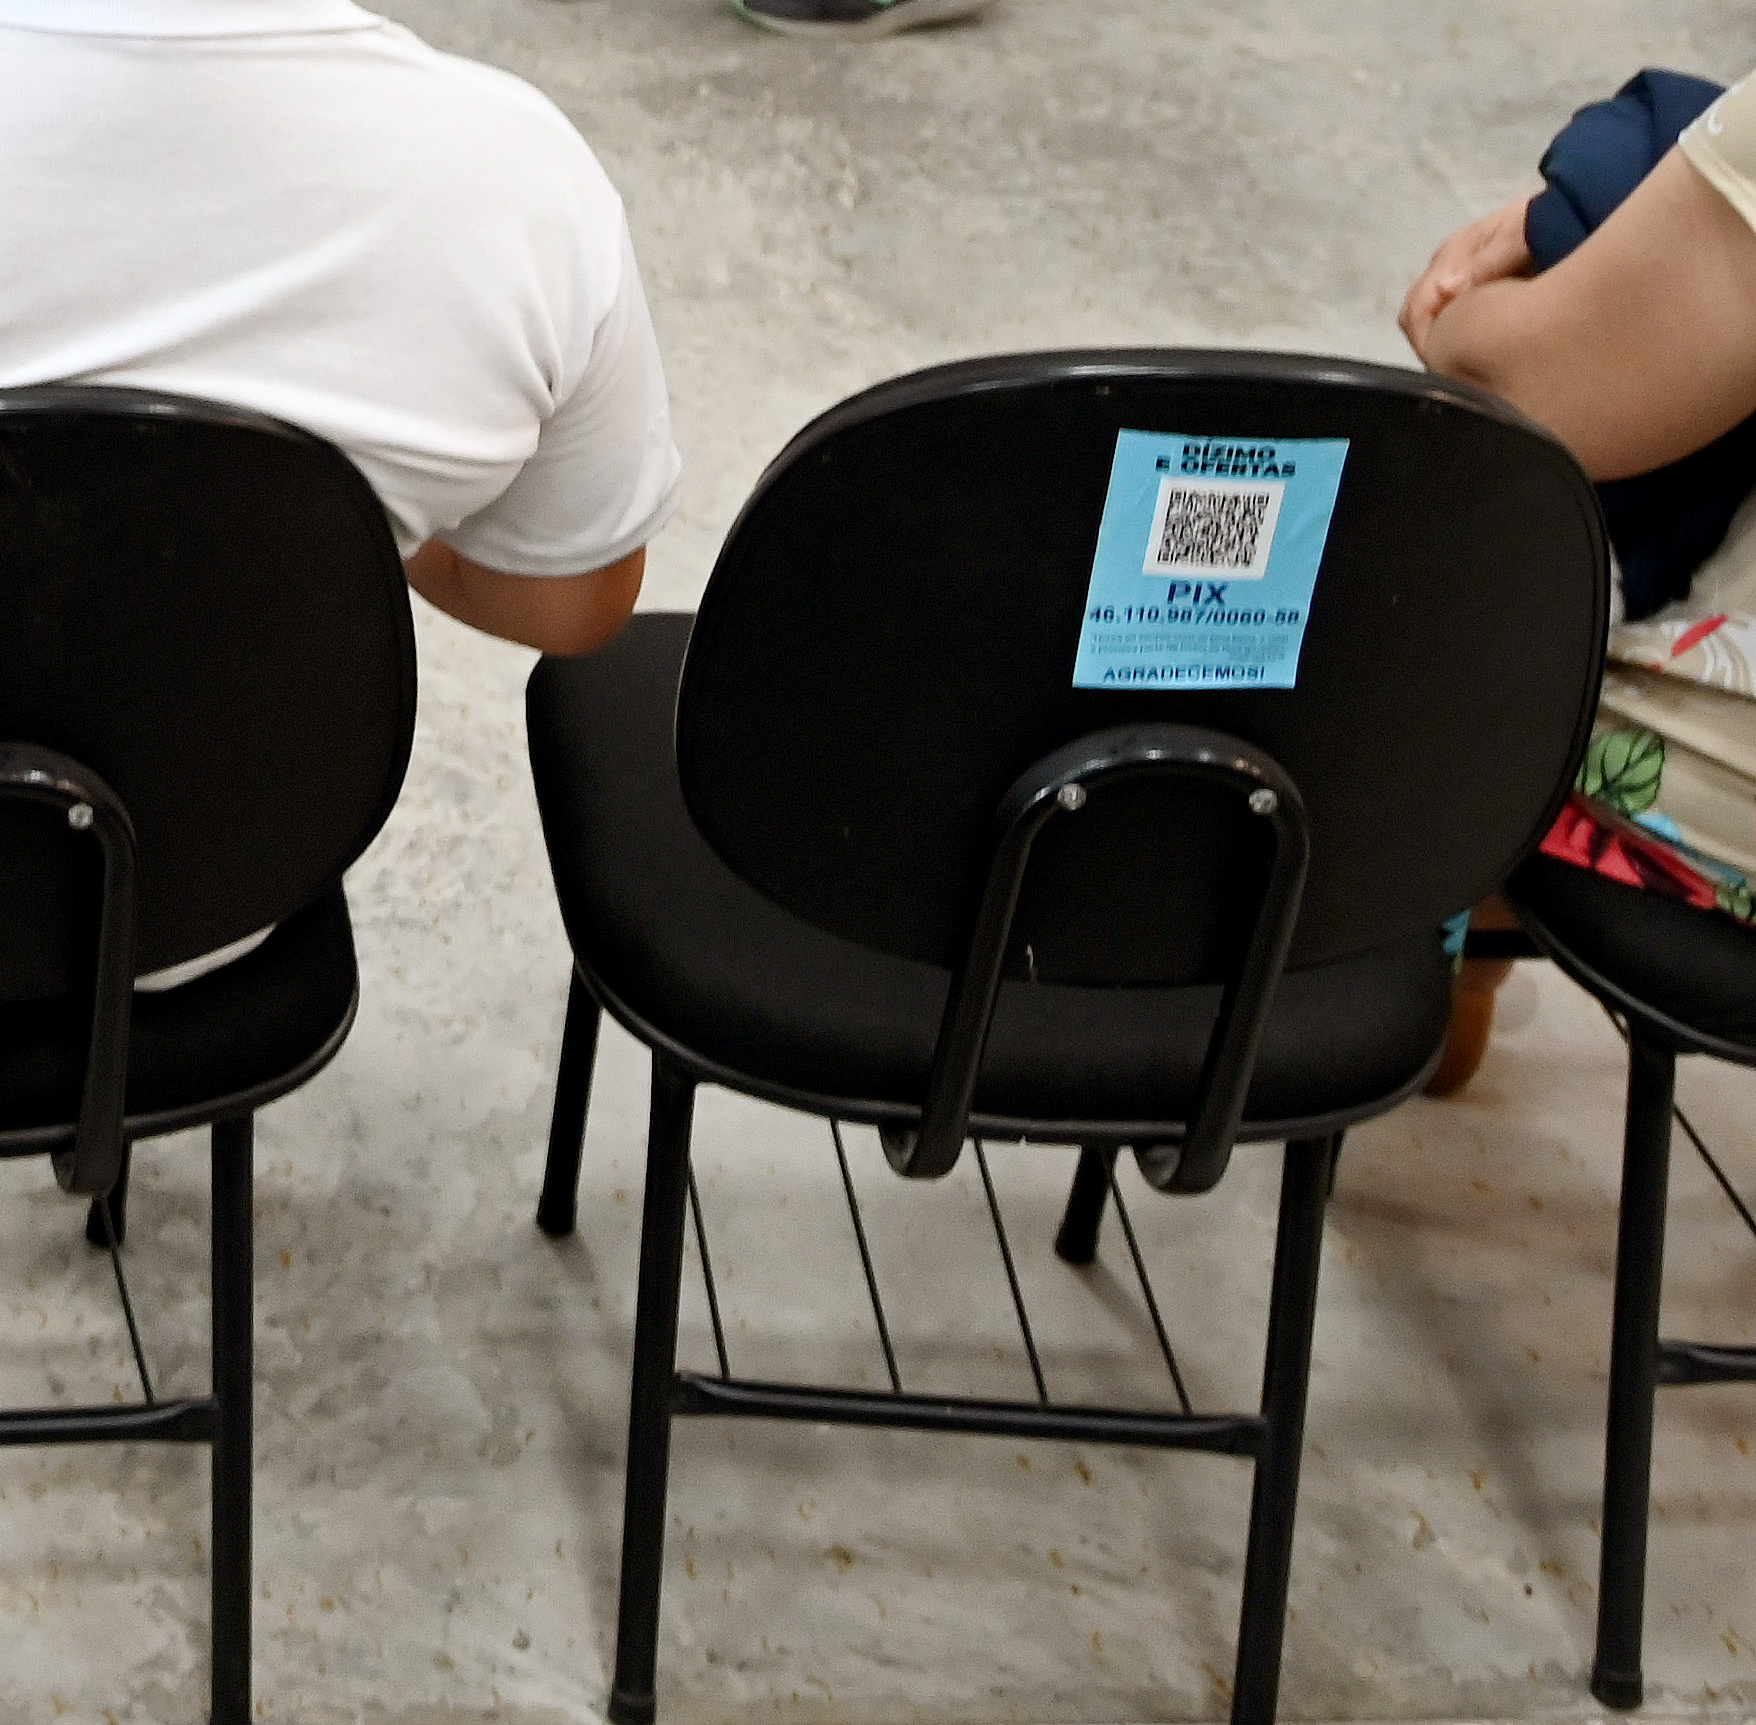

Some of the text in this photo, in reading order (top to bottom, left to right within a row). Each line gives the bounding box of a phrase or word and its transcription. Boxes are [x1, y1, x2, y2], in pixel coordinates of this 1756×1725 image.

[1181, 442, 1277, 459] DÍZIMO
[1155, 455, 1297, 478] E OFERTAS
[1167, 580, 1229, 606] PIX
[1103, 664, 1265, 682] AGRADECEMOS!
